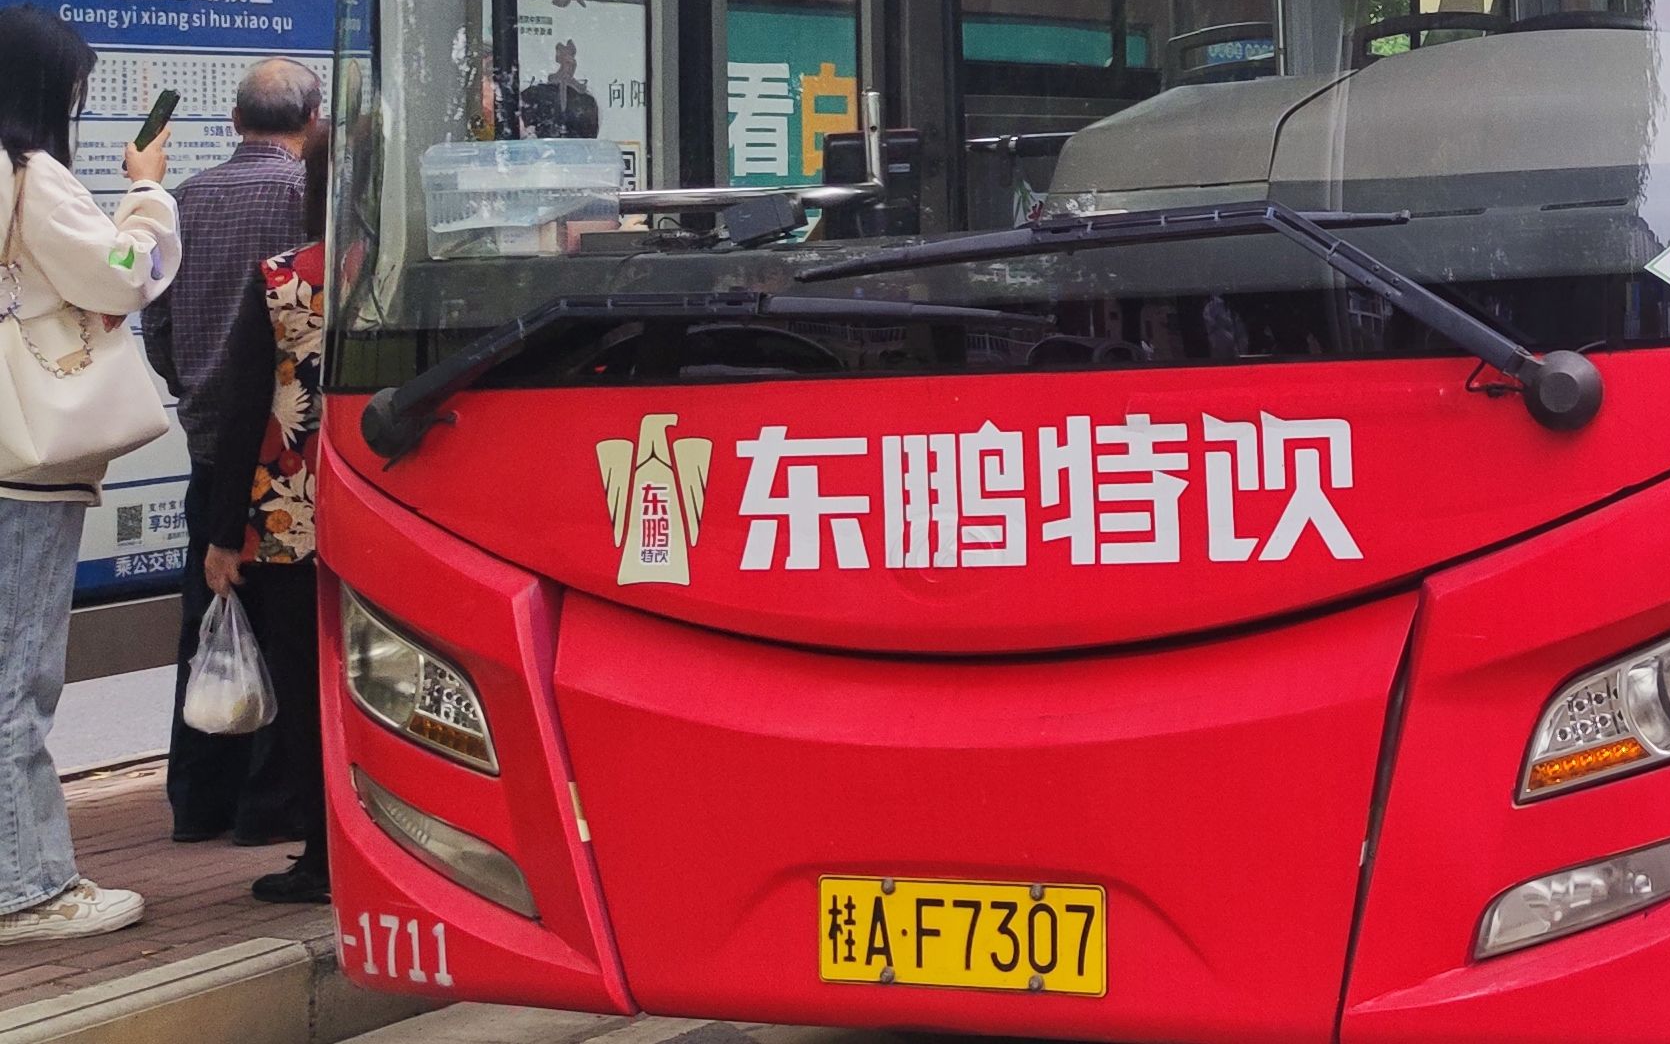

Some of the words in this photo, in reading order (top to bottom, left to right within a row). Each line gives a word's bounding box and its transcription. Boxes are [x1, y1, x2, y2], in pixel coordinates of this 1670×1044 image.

[59, 3, 119, 28] Guang
[121, 6, 138, 29] yi
[141, 8, 188, 32] xiang
[191, 10, 207, 28] si
[209, 10, 231, 28] hu
[234, 11, 269, 30] xiao
[272, 15, 293, 34] qu
[735, 411, 1364, 571] 东鹏特饮
